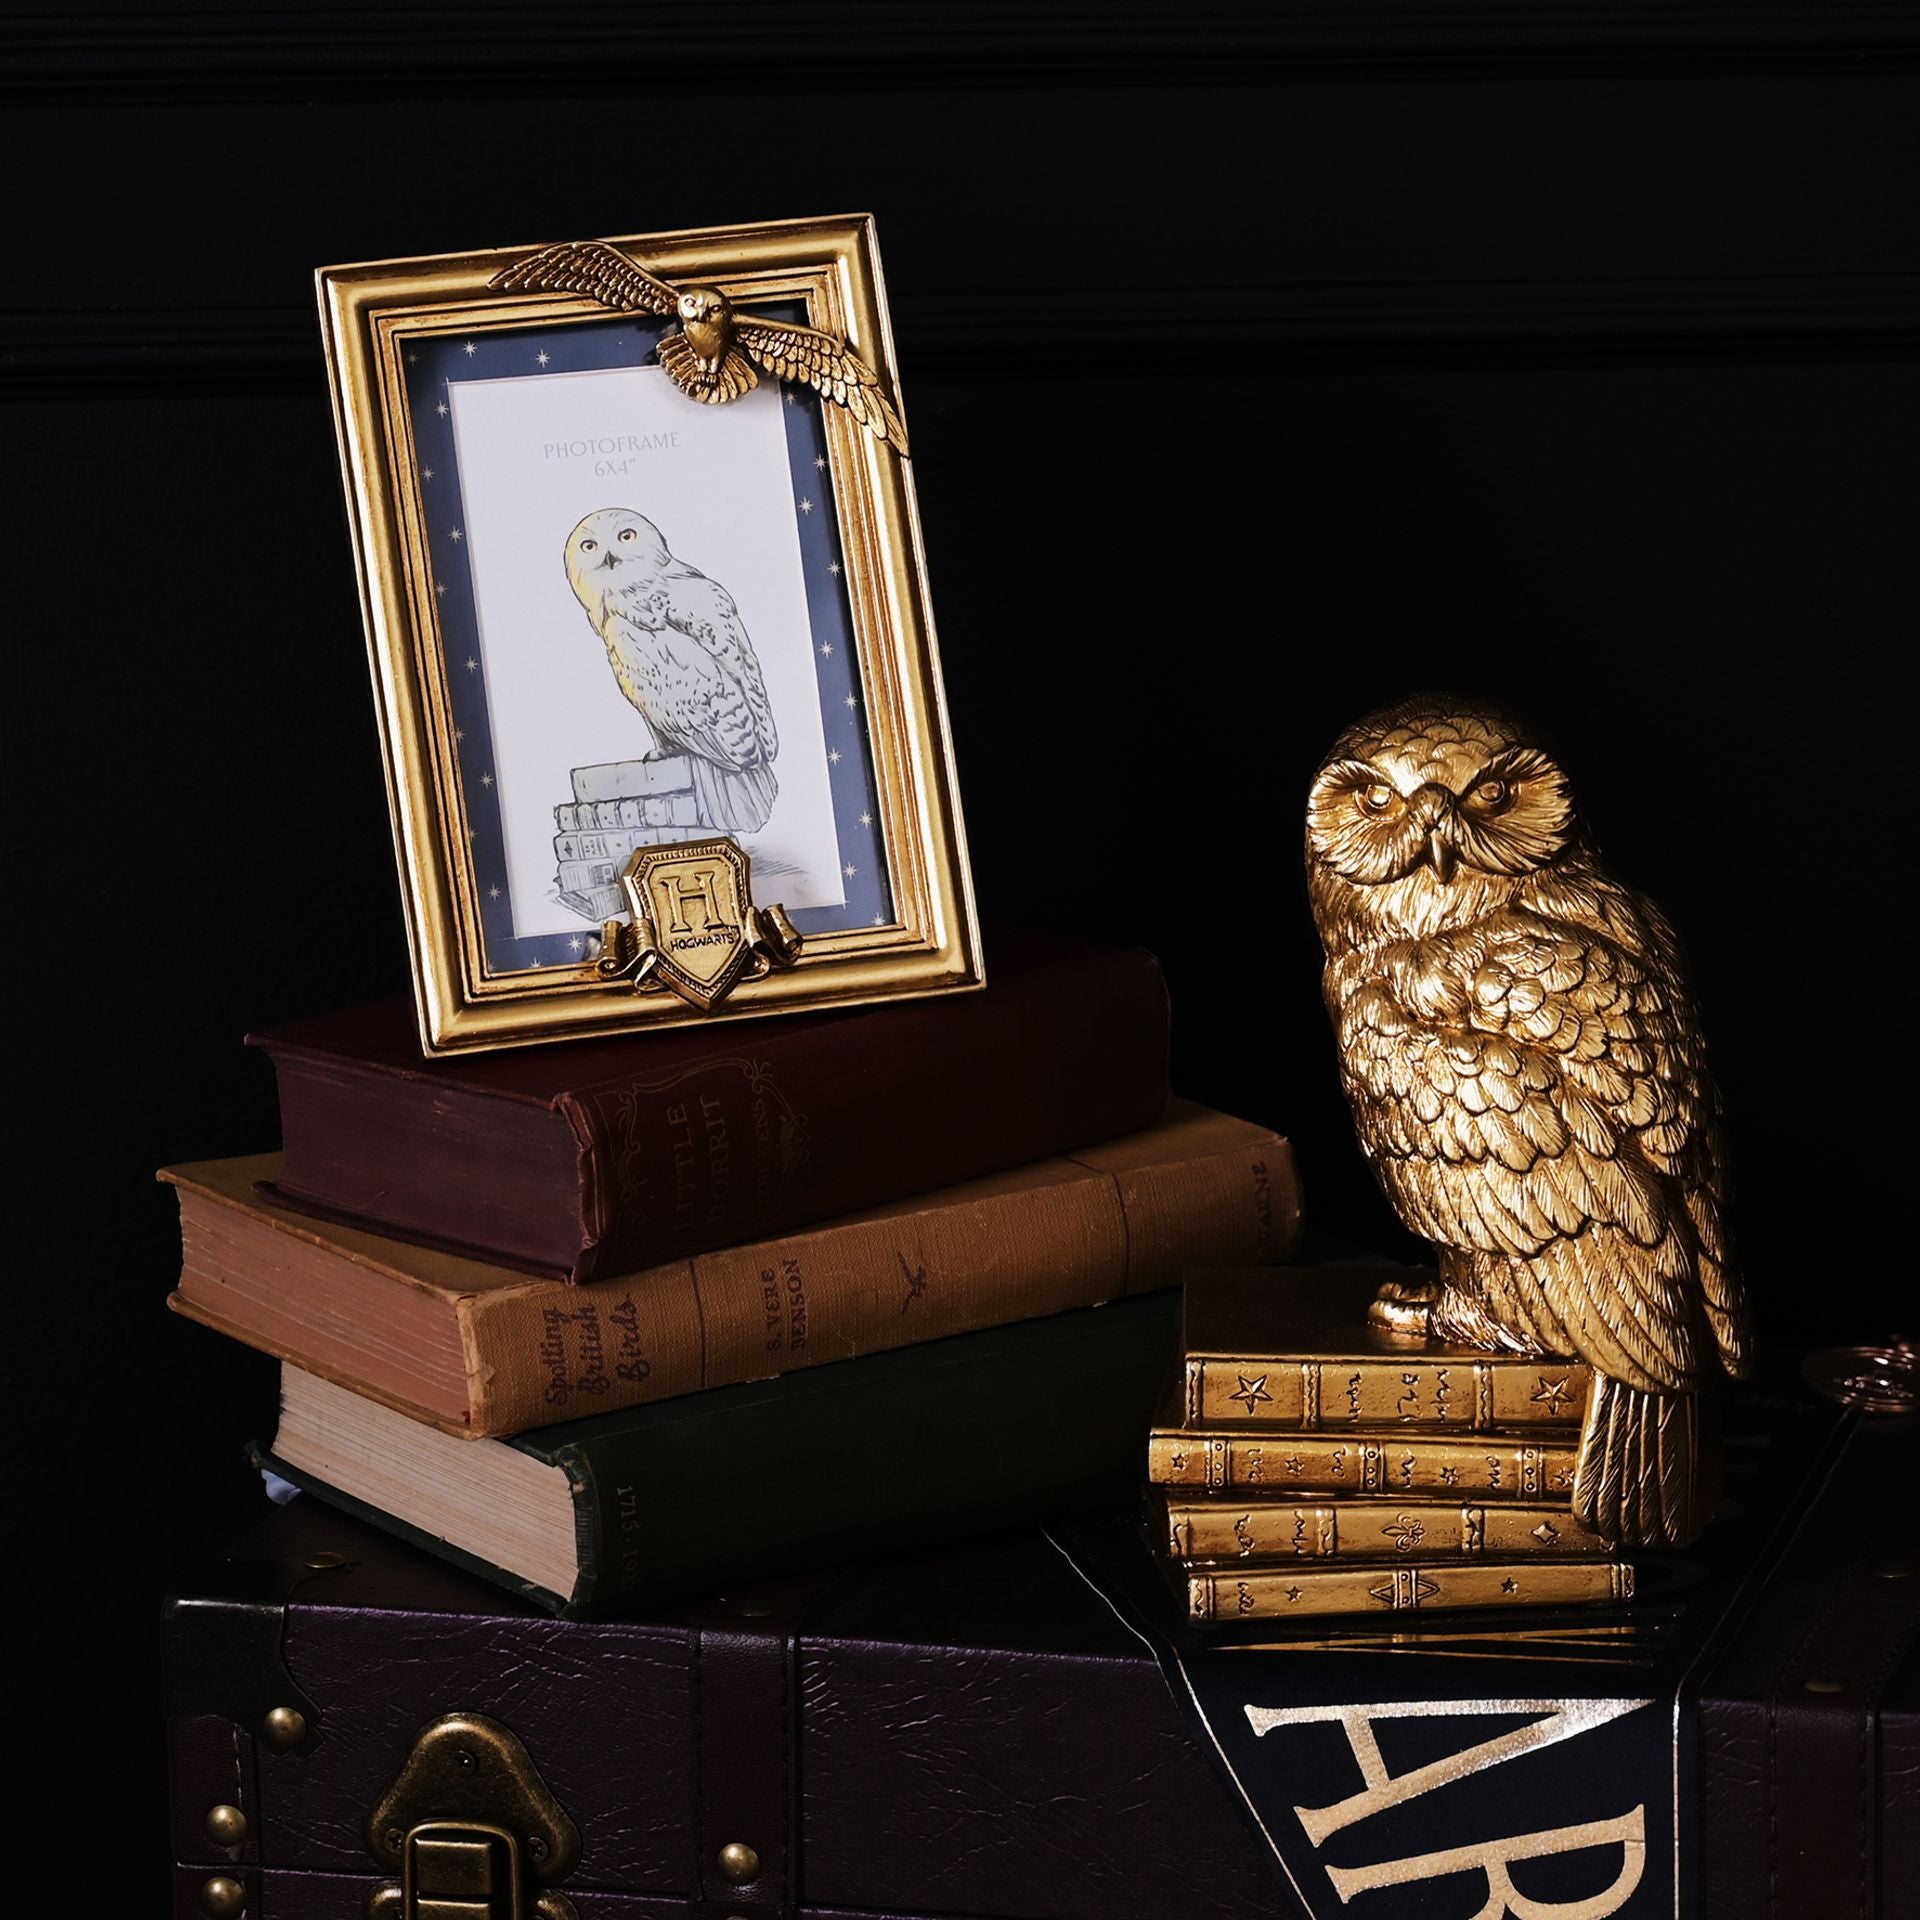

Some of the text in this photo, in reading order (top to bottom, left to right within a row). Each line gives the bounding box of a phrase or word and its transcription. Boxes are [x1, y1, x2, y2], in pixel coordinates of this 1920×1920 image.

[543, 431, 682, 460] PHOTOFRAME
[659, 871, 725, 933] H
[670, 932, 735, 952] HOGWARTS
[665, 1103, 696, 1233] LITTLE
[699, 1094, 729, 1225] DORRIT
[610, 1292, 650, 1381] Birds
[761, 1268, 780, 1331] VERE
[782, 1258, 807, 1351] BENSON
[540, 1307, 578, 1406] Spotting
[577, 1303, 611, 1396] British
